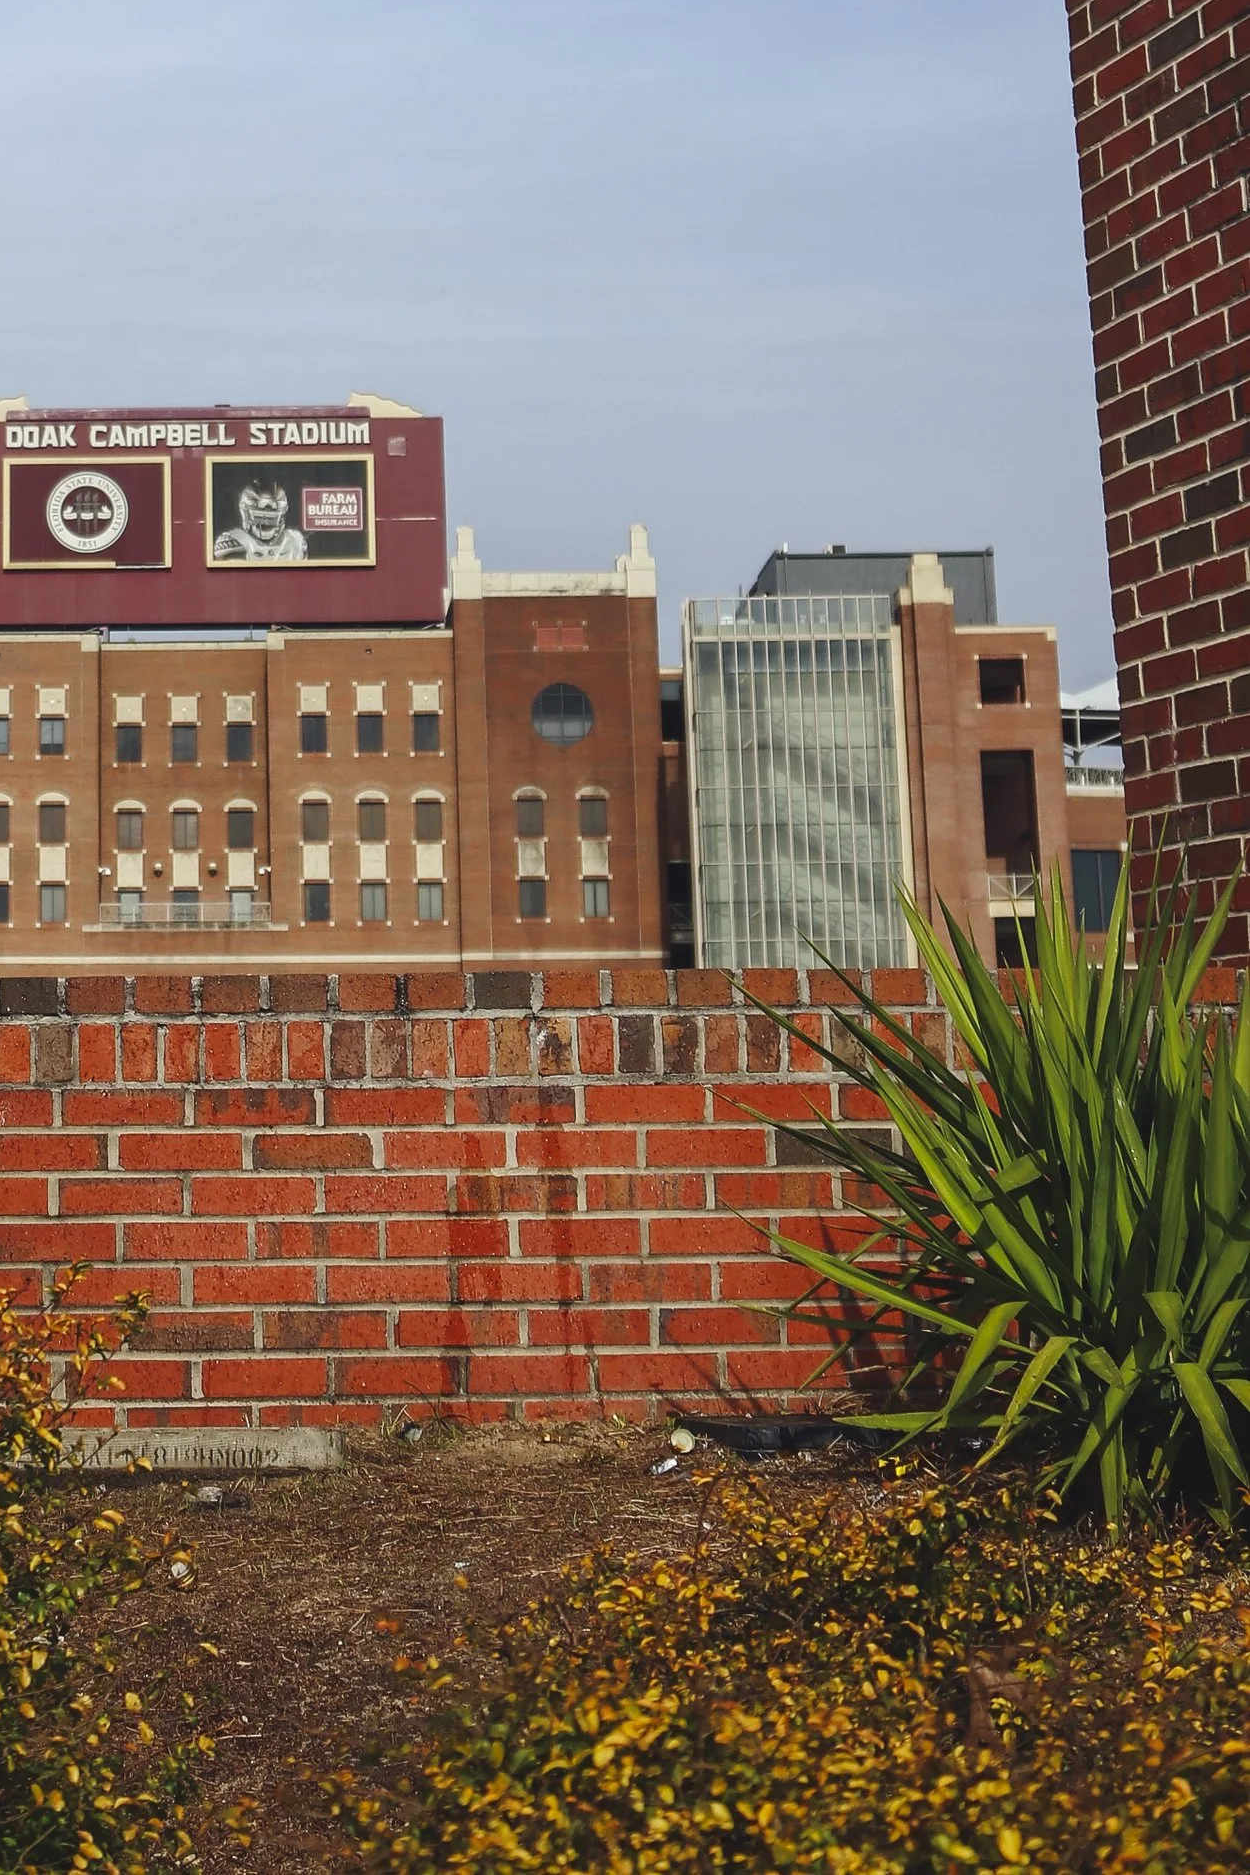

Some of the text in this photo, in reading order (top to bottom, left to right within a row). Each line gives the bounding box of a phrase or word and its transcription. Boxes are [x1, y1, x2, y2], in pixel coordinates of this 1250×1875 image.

[5, 422, 370, 448] DOAK CAMPBELL STADIUM
[322, 492, 357, 504] FARM
[51, 476, 124, 534] FLORIDA STATE UNIVERSITY
[308, 504, 358, 516] BUREAU
[77, 540, 97, 548] 1851
